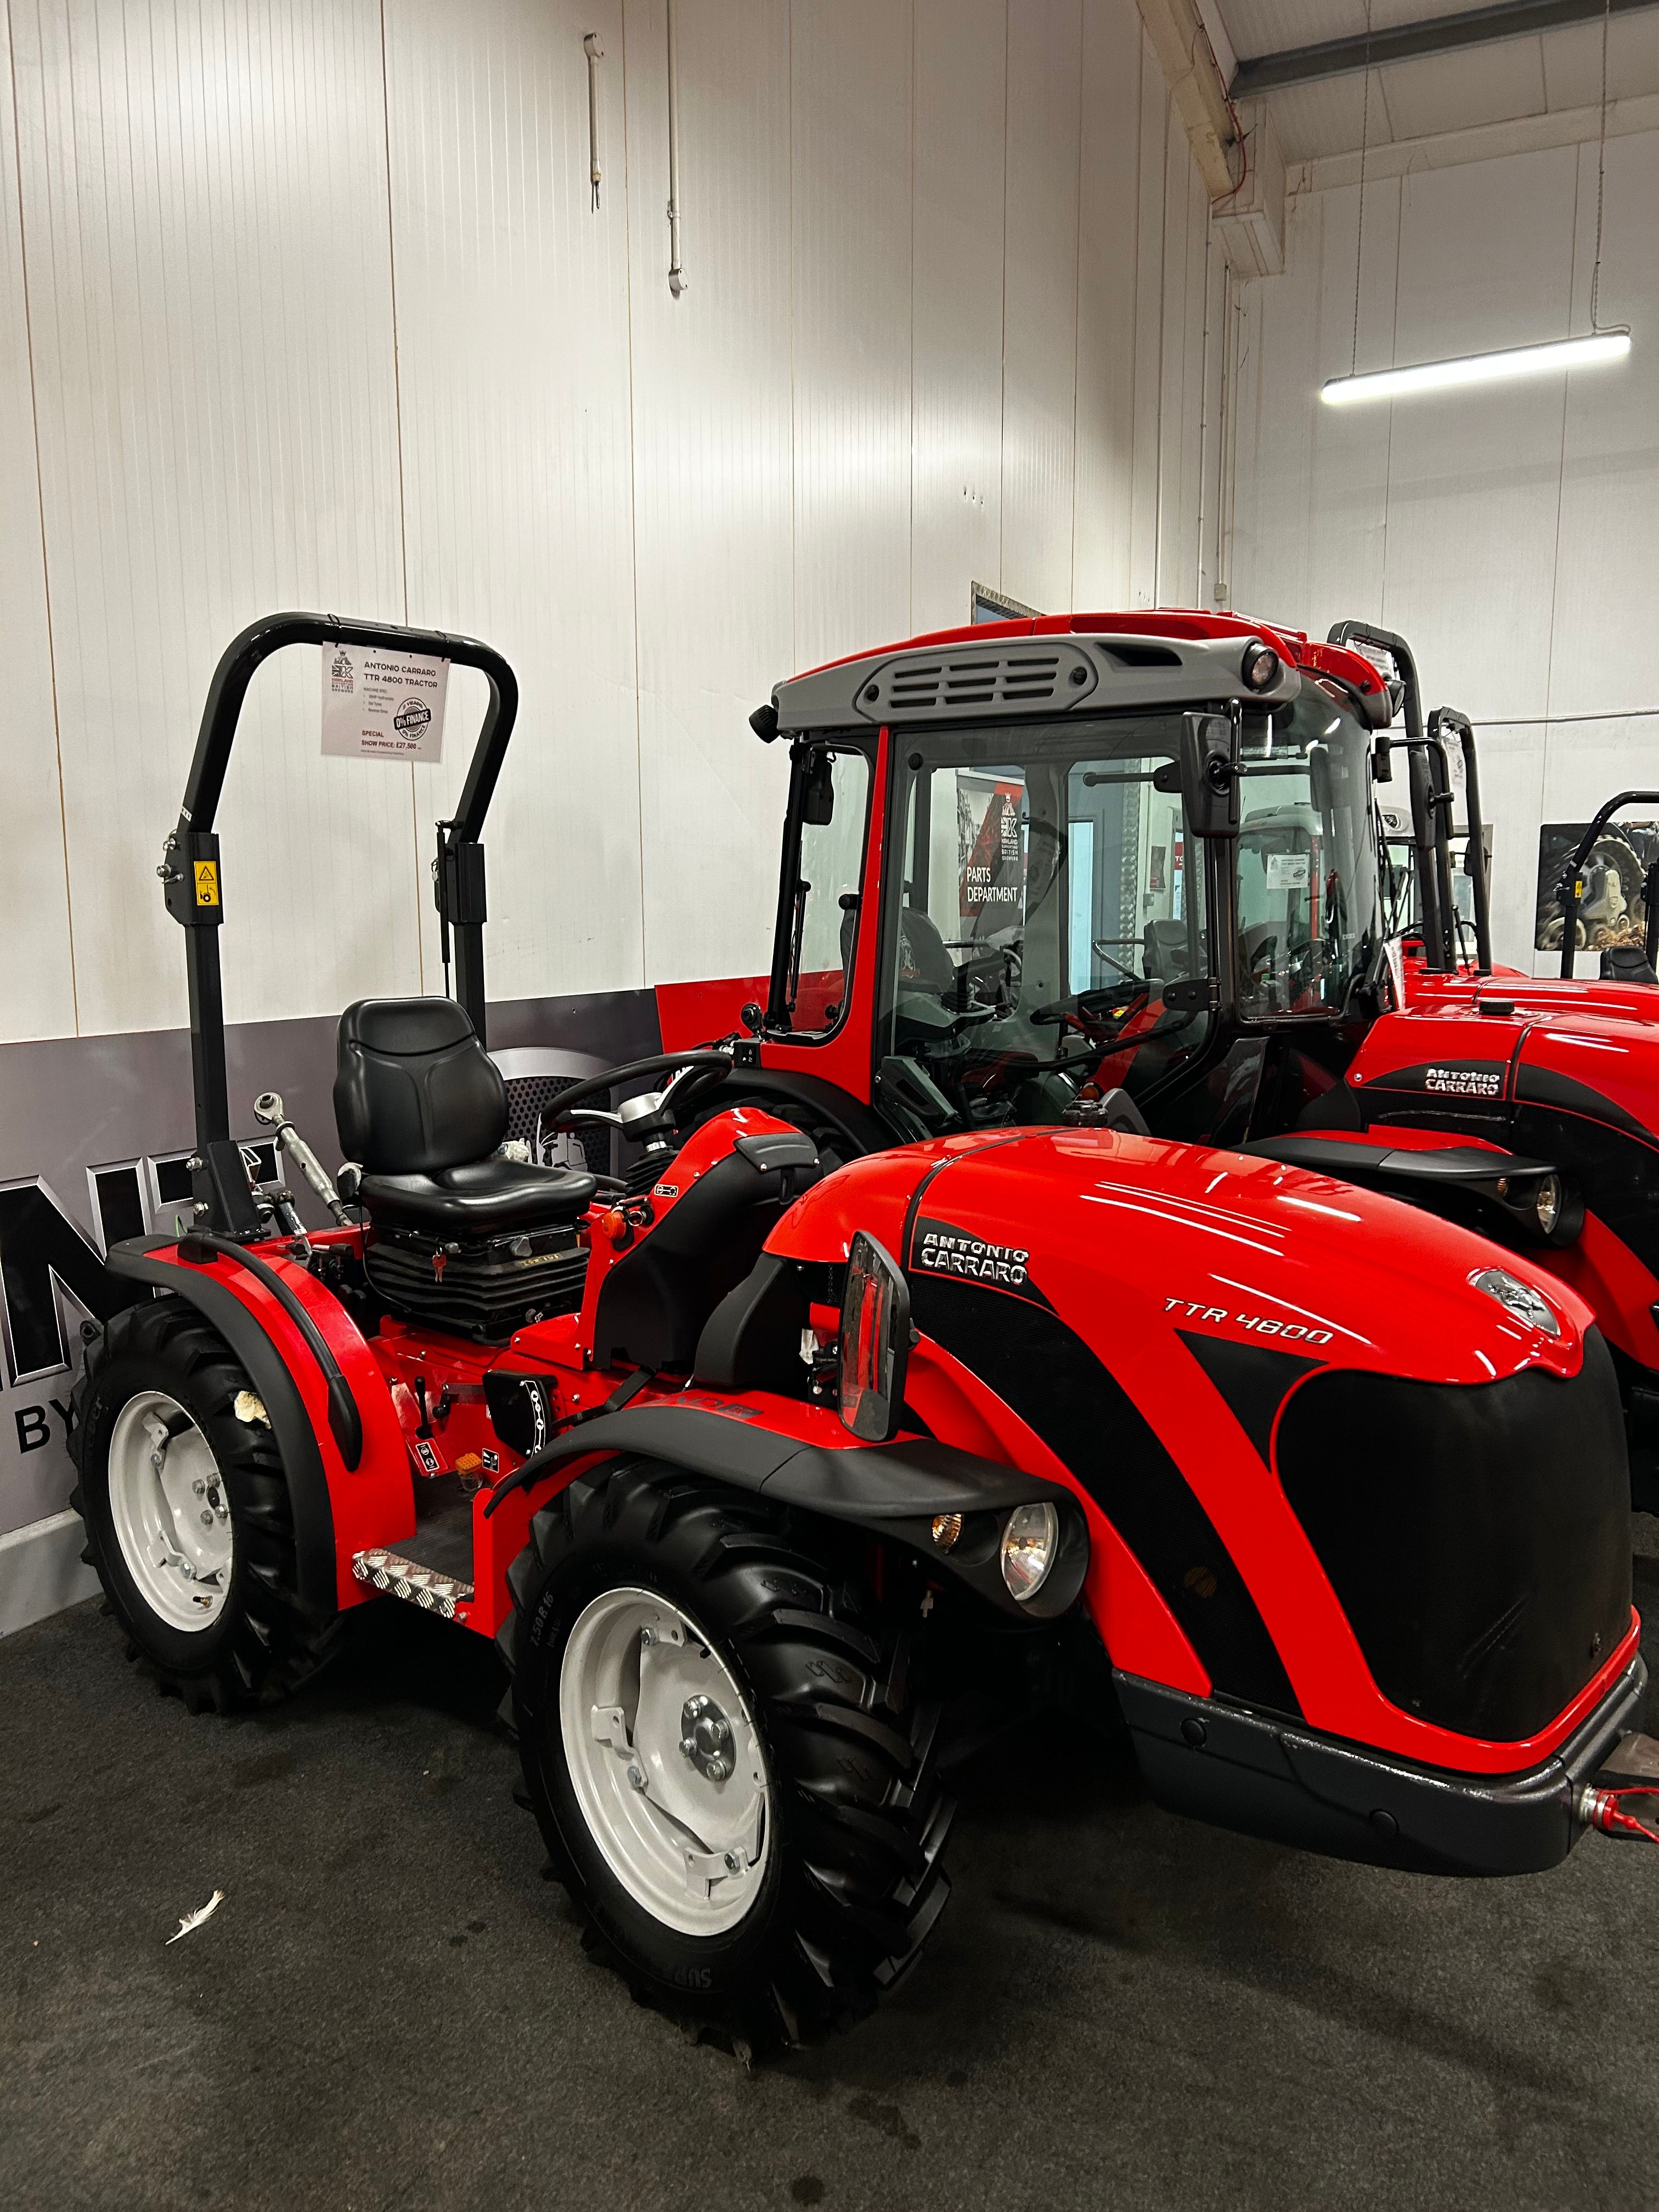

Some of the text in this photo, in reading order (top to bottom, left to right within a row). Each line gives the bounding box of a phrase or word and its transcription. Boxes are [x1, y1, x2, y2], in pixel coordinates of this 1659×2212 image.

[364, 662, 436, 676] ANTONIO CARRARO
[405, 678, 438, 688] TRACTOR
[397, 711, 429, 728] 0% FINANCE
[410, 724, 426, 738] FINANCE
[967, 866, 991, 883] PARTS
[967, 887, 1018, 902] DEPARTMENT
[1426, 1068, 1500, 1083] ANTONIO
[1425, 1079, 1499, 1096] CARRARO
[923, 1233, 1029, 1262] ANTONIO
[921, 1248, 1027, 1285] CARRARO
[1165, 1297, 1334, 1344] TTR 4800
[530, 1592, 554, 1646] 7.50 R 16
